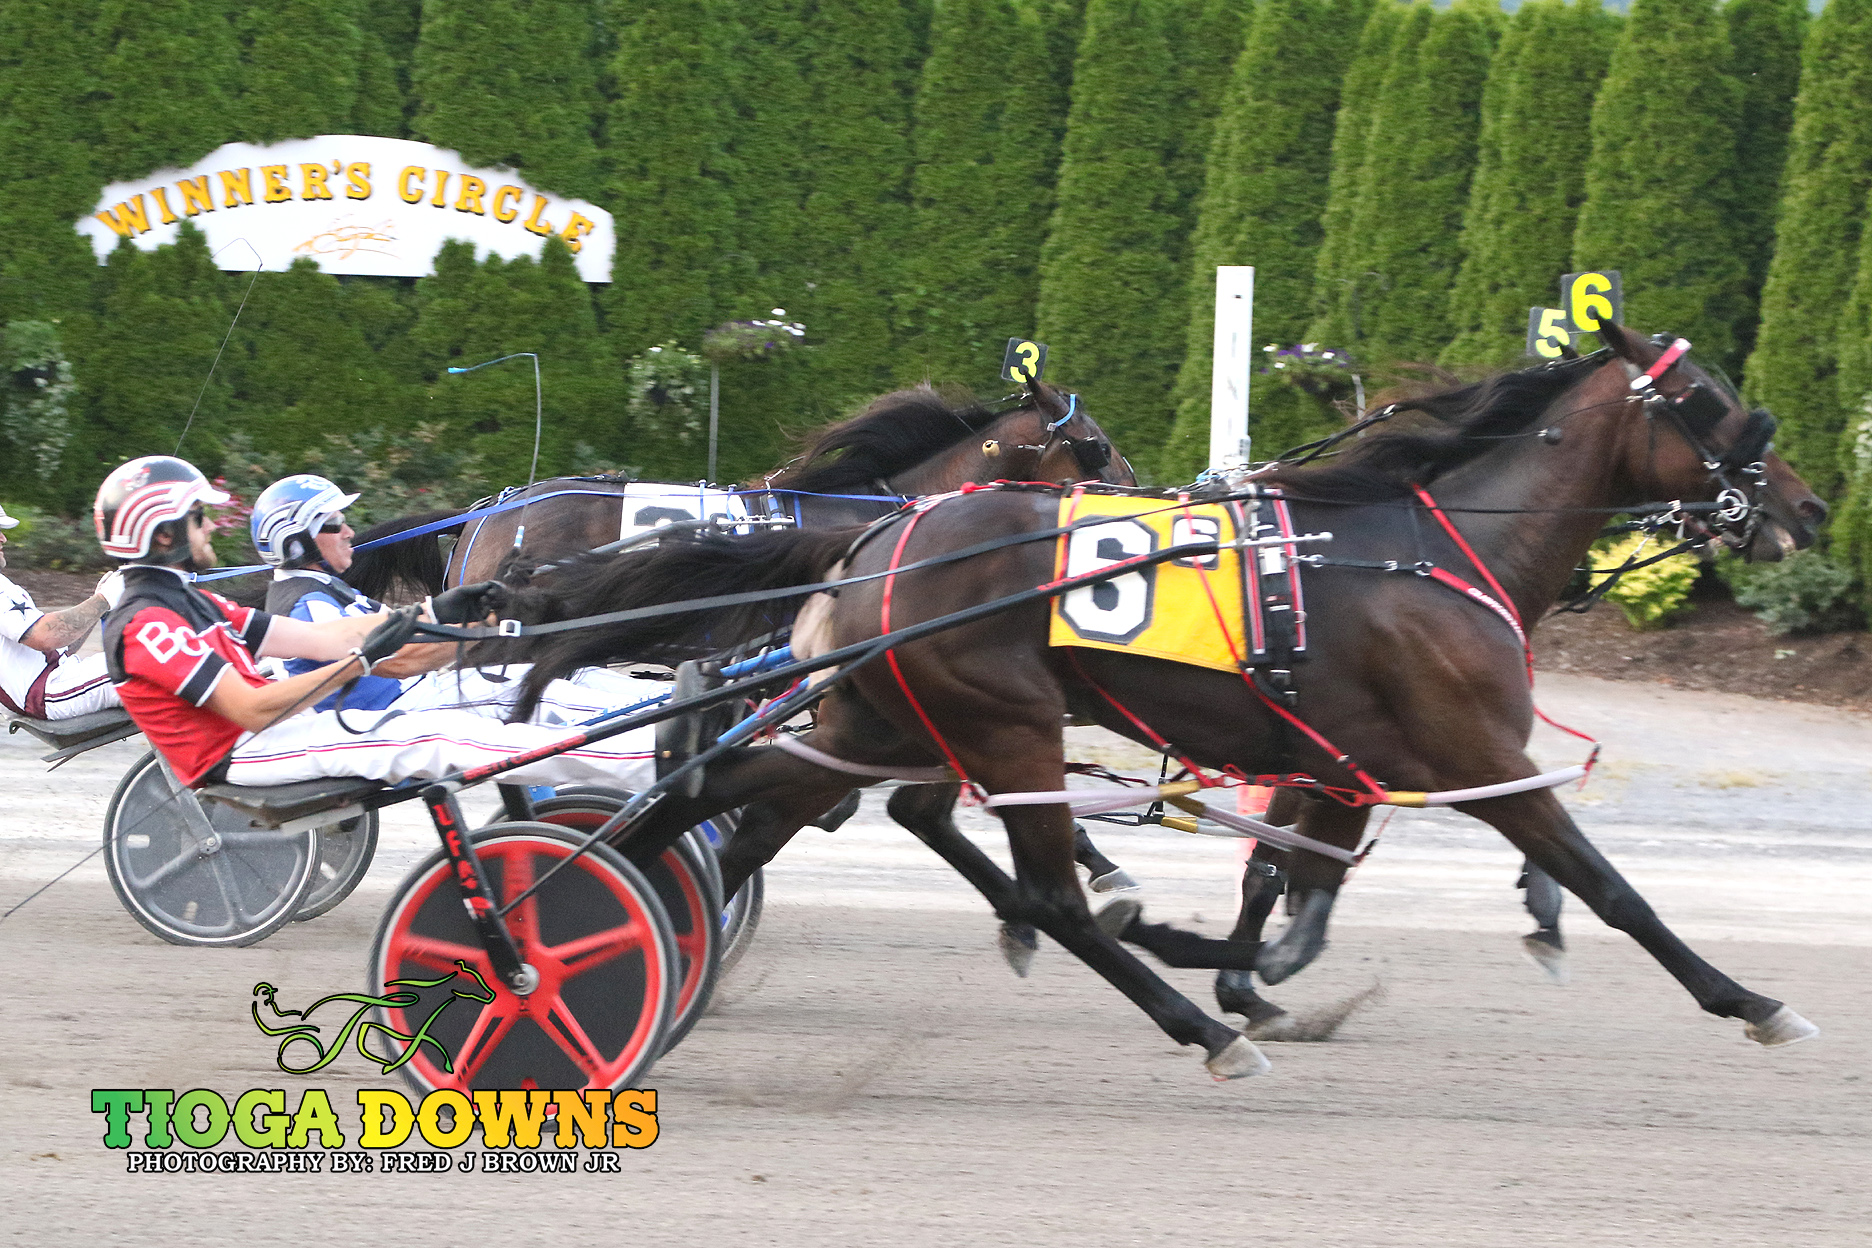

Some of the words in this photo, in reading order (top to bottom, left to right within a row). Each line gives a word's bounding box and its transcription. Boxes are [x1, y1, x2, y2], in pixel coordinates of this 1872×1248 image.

[96, 159, 372, 238] WINNER'S
[398, 166, 594, 254] CIRCLE
[1571, 272, 1613, 332] 6
[1010, 341, 1040, 383] 3
[1535, 308, 1570, 358] 5
[1063, 518, 1154, 640] 6
[1173, 518, 1219, 563] 6
